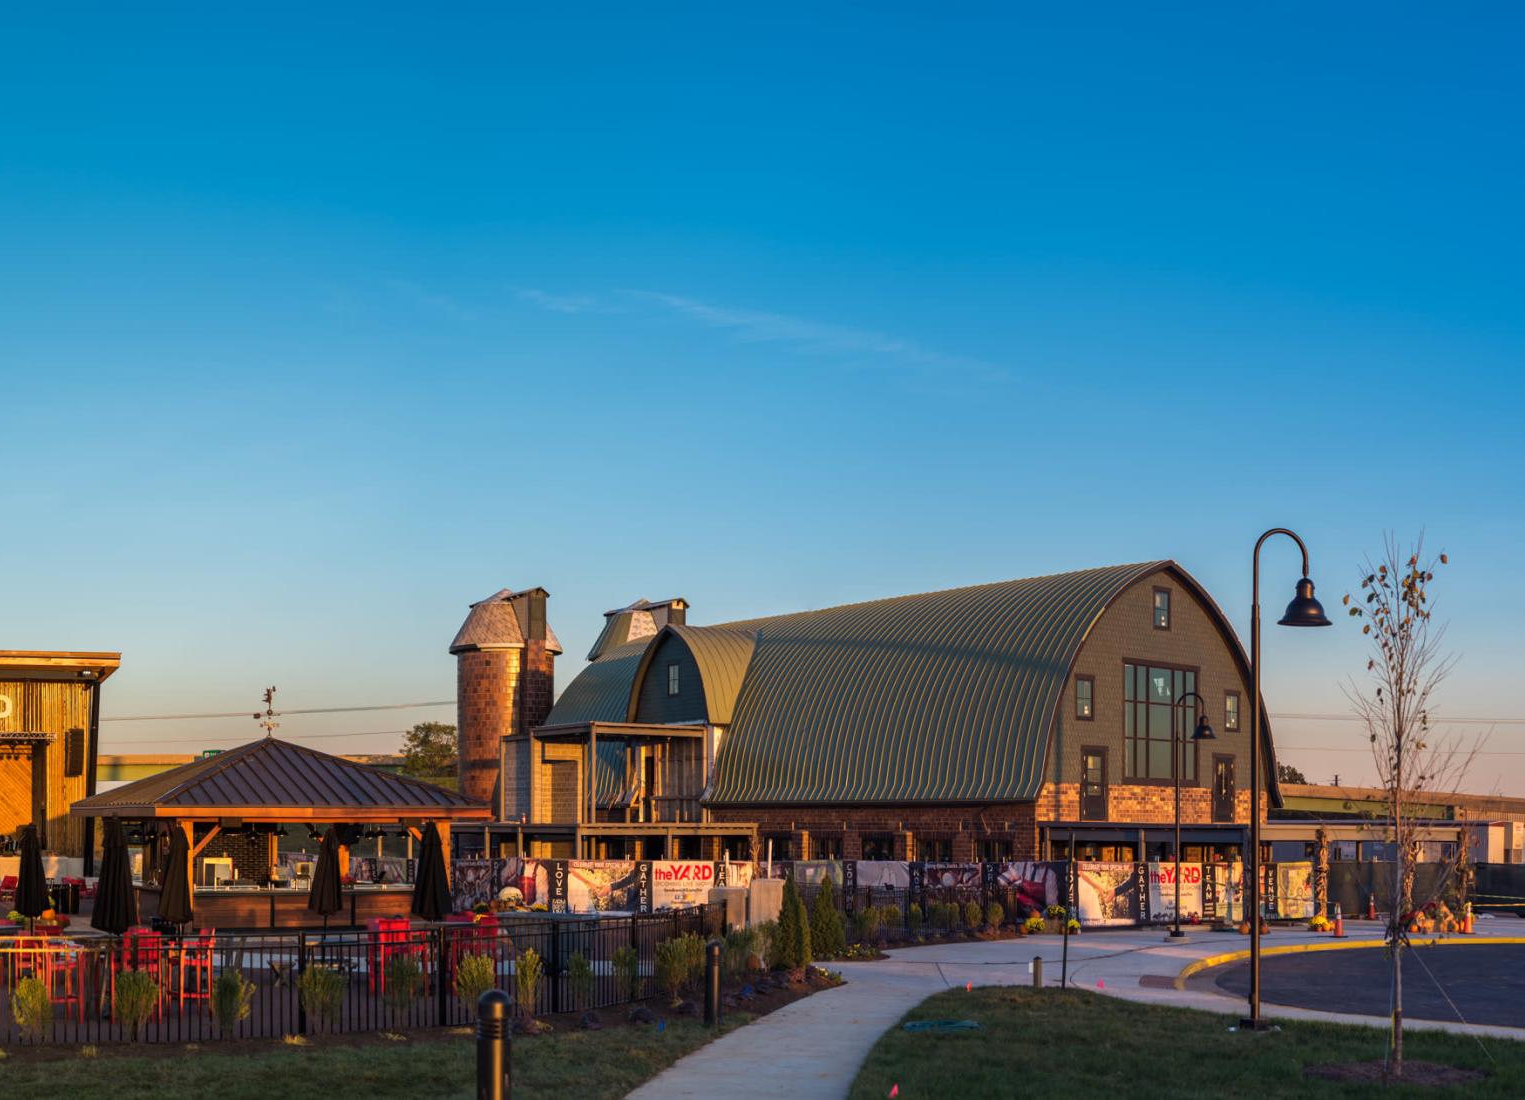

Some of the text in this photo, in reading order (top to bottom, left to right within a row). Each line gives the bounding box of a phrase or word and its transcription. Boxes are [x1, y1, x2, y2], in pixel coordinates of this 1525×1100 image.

[555, 862, 563, 896] LOVE
[639, 864, 647, 913] GATHER
[1138, 866, 1146, 919] GATHER
